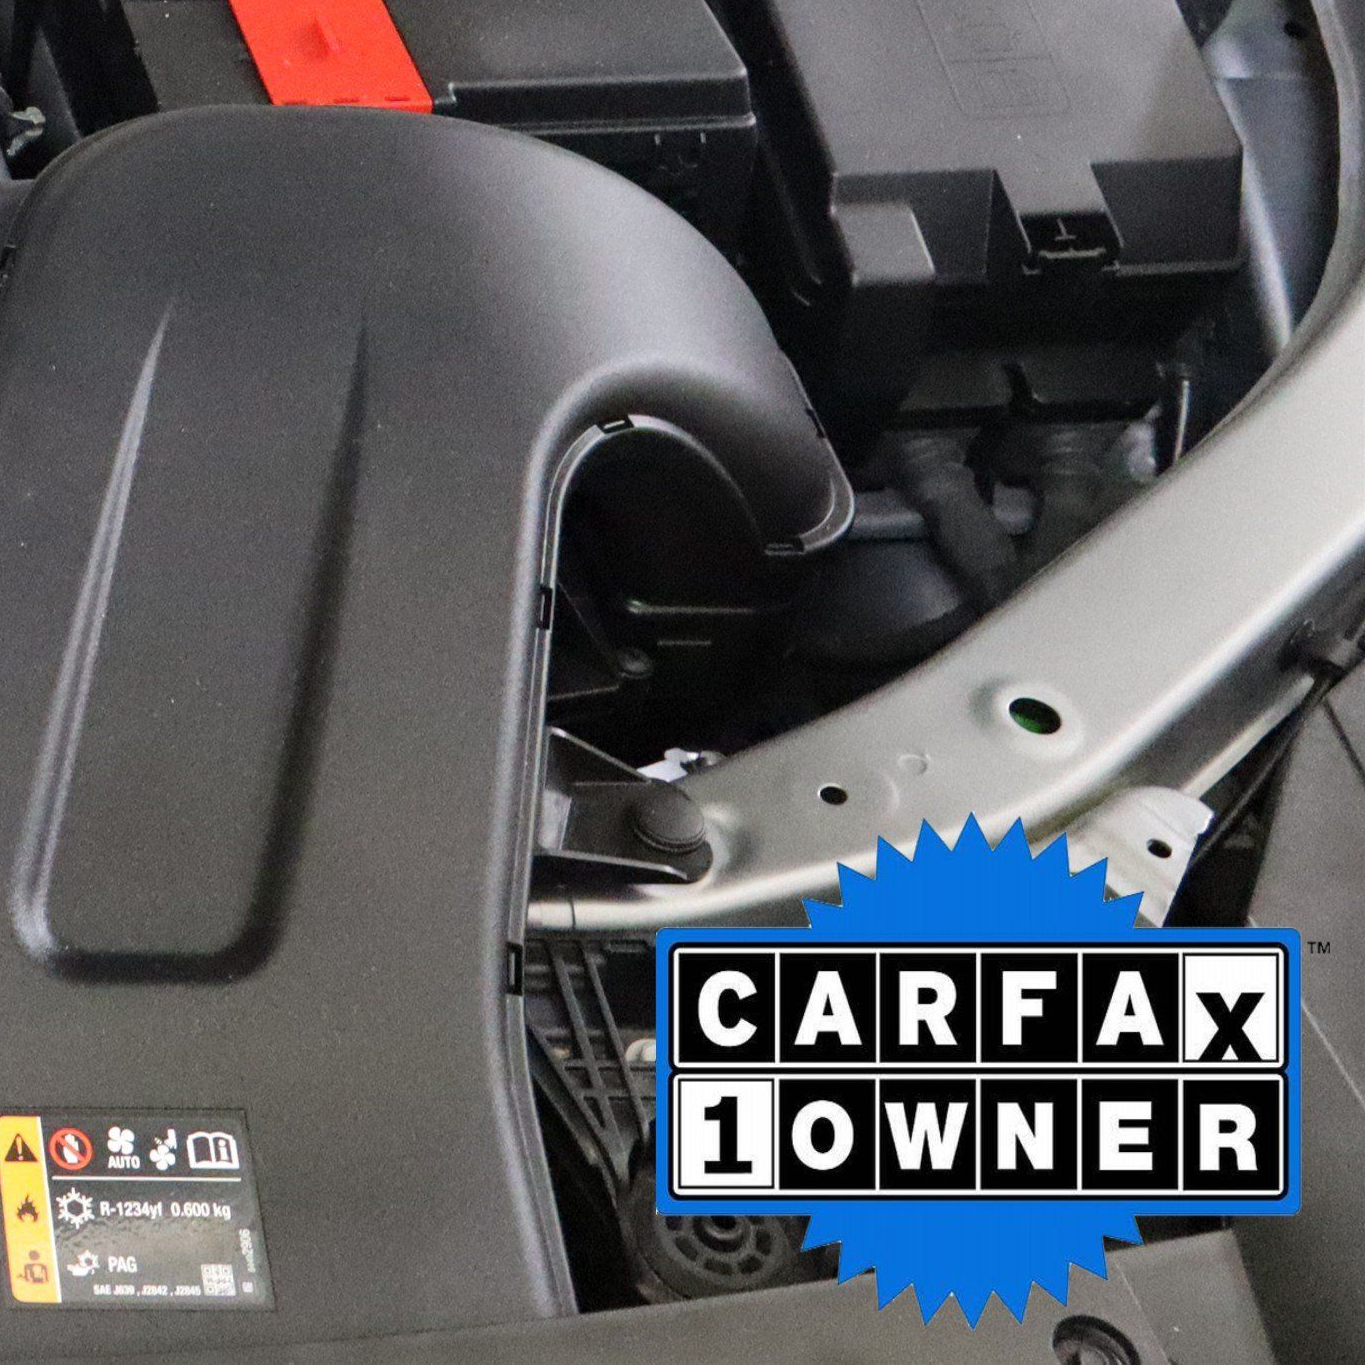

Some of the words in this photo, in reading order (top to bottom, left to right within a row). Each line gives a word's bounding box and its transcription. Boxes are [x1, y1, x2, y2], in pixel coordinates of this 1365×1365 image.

[107, 1154, 140, 1170] AUTO
[100, 1201, 162, 1220] R-1234yf
[171, 1201, 209, 1218] 0.600
[213, 1202, 231, 1220] kg
[107, 1255, 137, 1273] PAG
